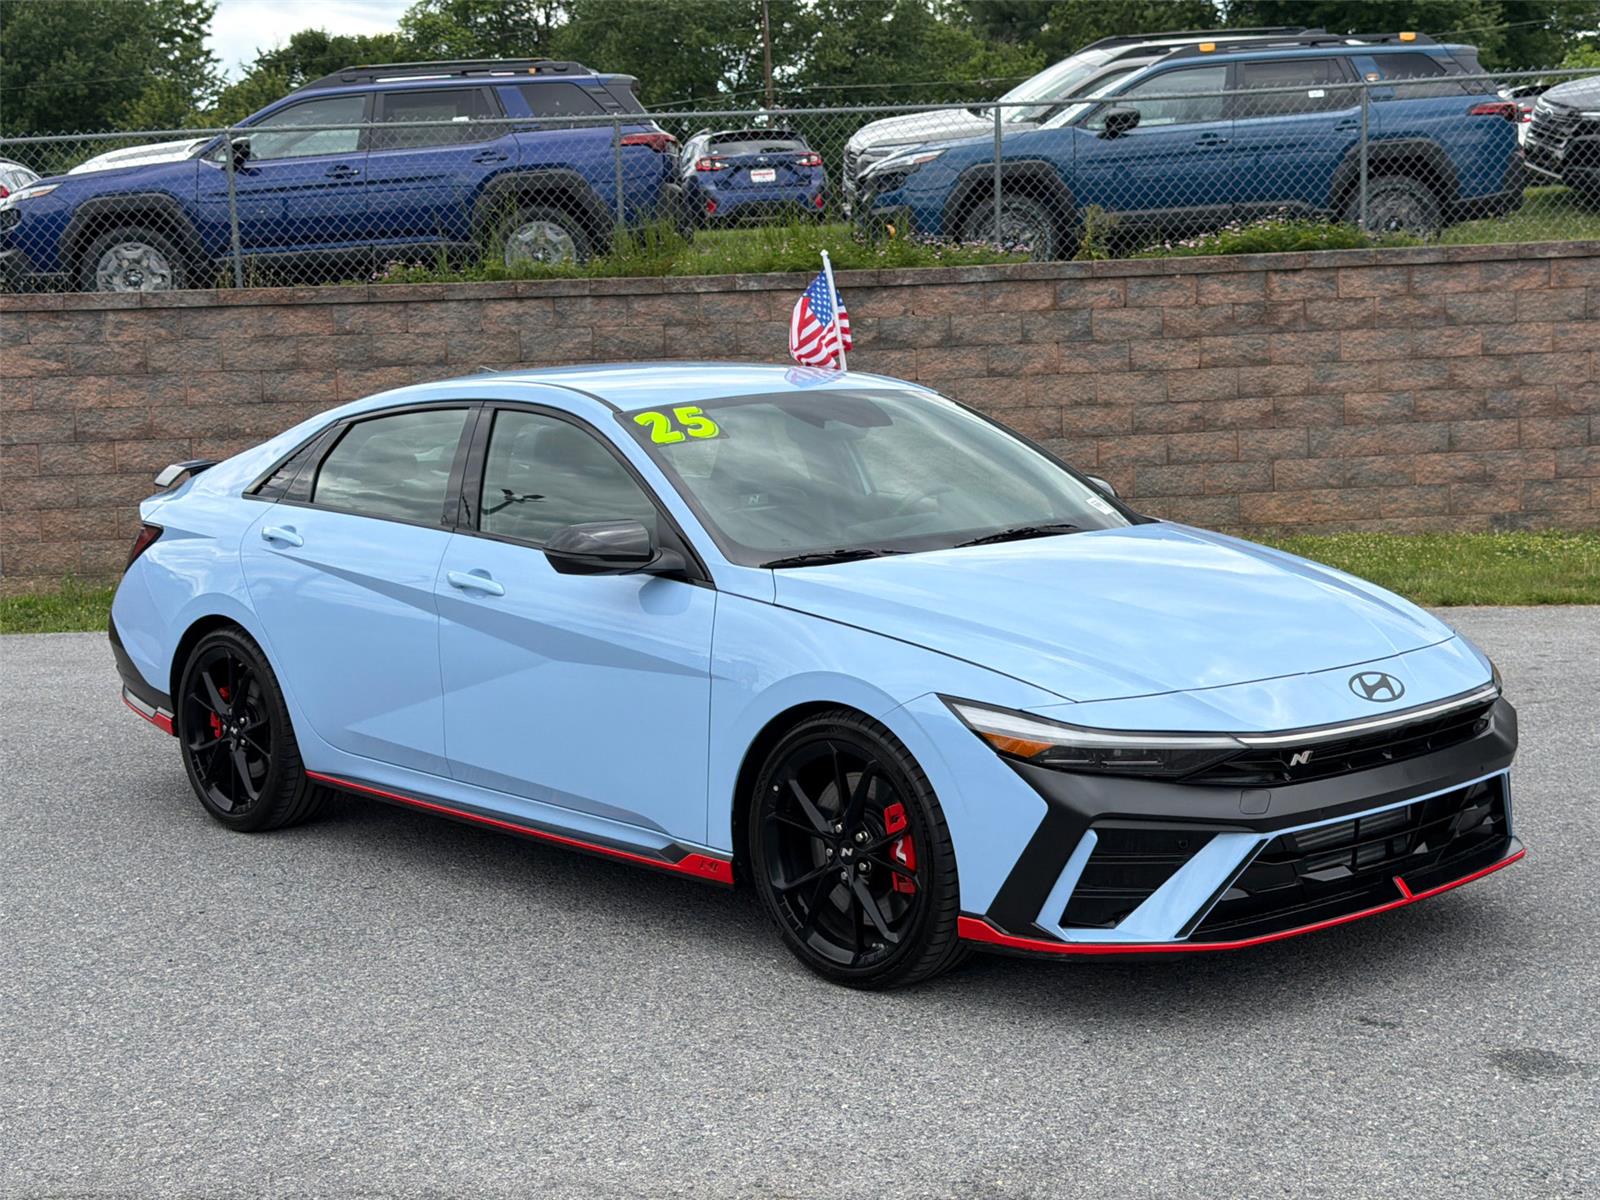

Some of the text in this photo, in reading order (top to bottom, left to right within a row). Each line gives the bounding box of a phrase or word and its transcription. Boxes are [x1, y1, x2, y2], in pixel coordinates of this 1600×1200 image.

[633, 406, 719, 443] 25
[1290, 750, 1313, 766] N
[841, 847, 853, 856] N
